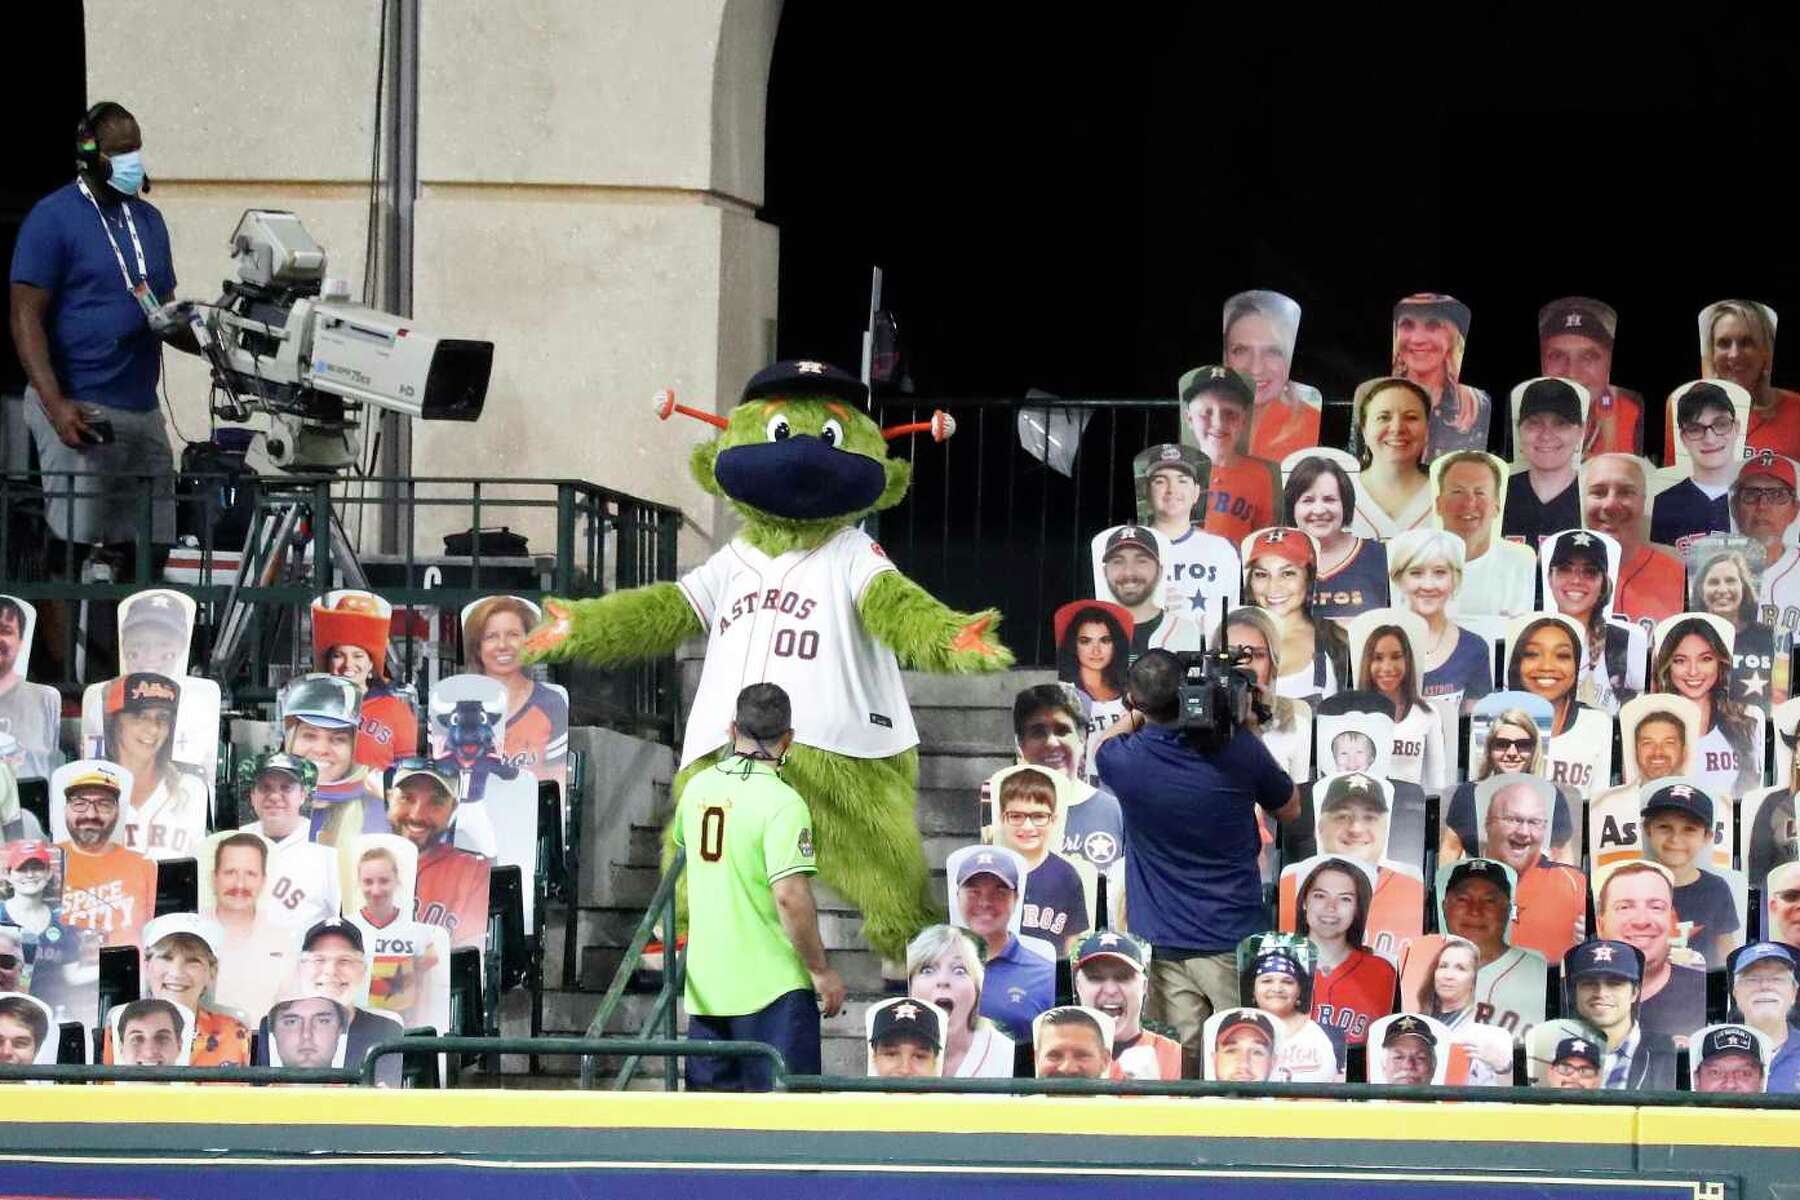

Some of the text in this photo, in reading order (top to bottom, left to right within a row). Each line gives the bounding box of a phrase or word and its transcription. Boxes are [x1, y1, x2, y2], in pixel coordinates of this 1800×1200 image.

[1167, 563, 1217, 582] ros
[719, 588, 817, 636] ASTROS
[774, 628, 820, 660] 00
[1392, 739, 1422, 756] ROS
[700, 806, 725, 862] 0
[61, 880, 124, 912] SPACE
